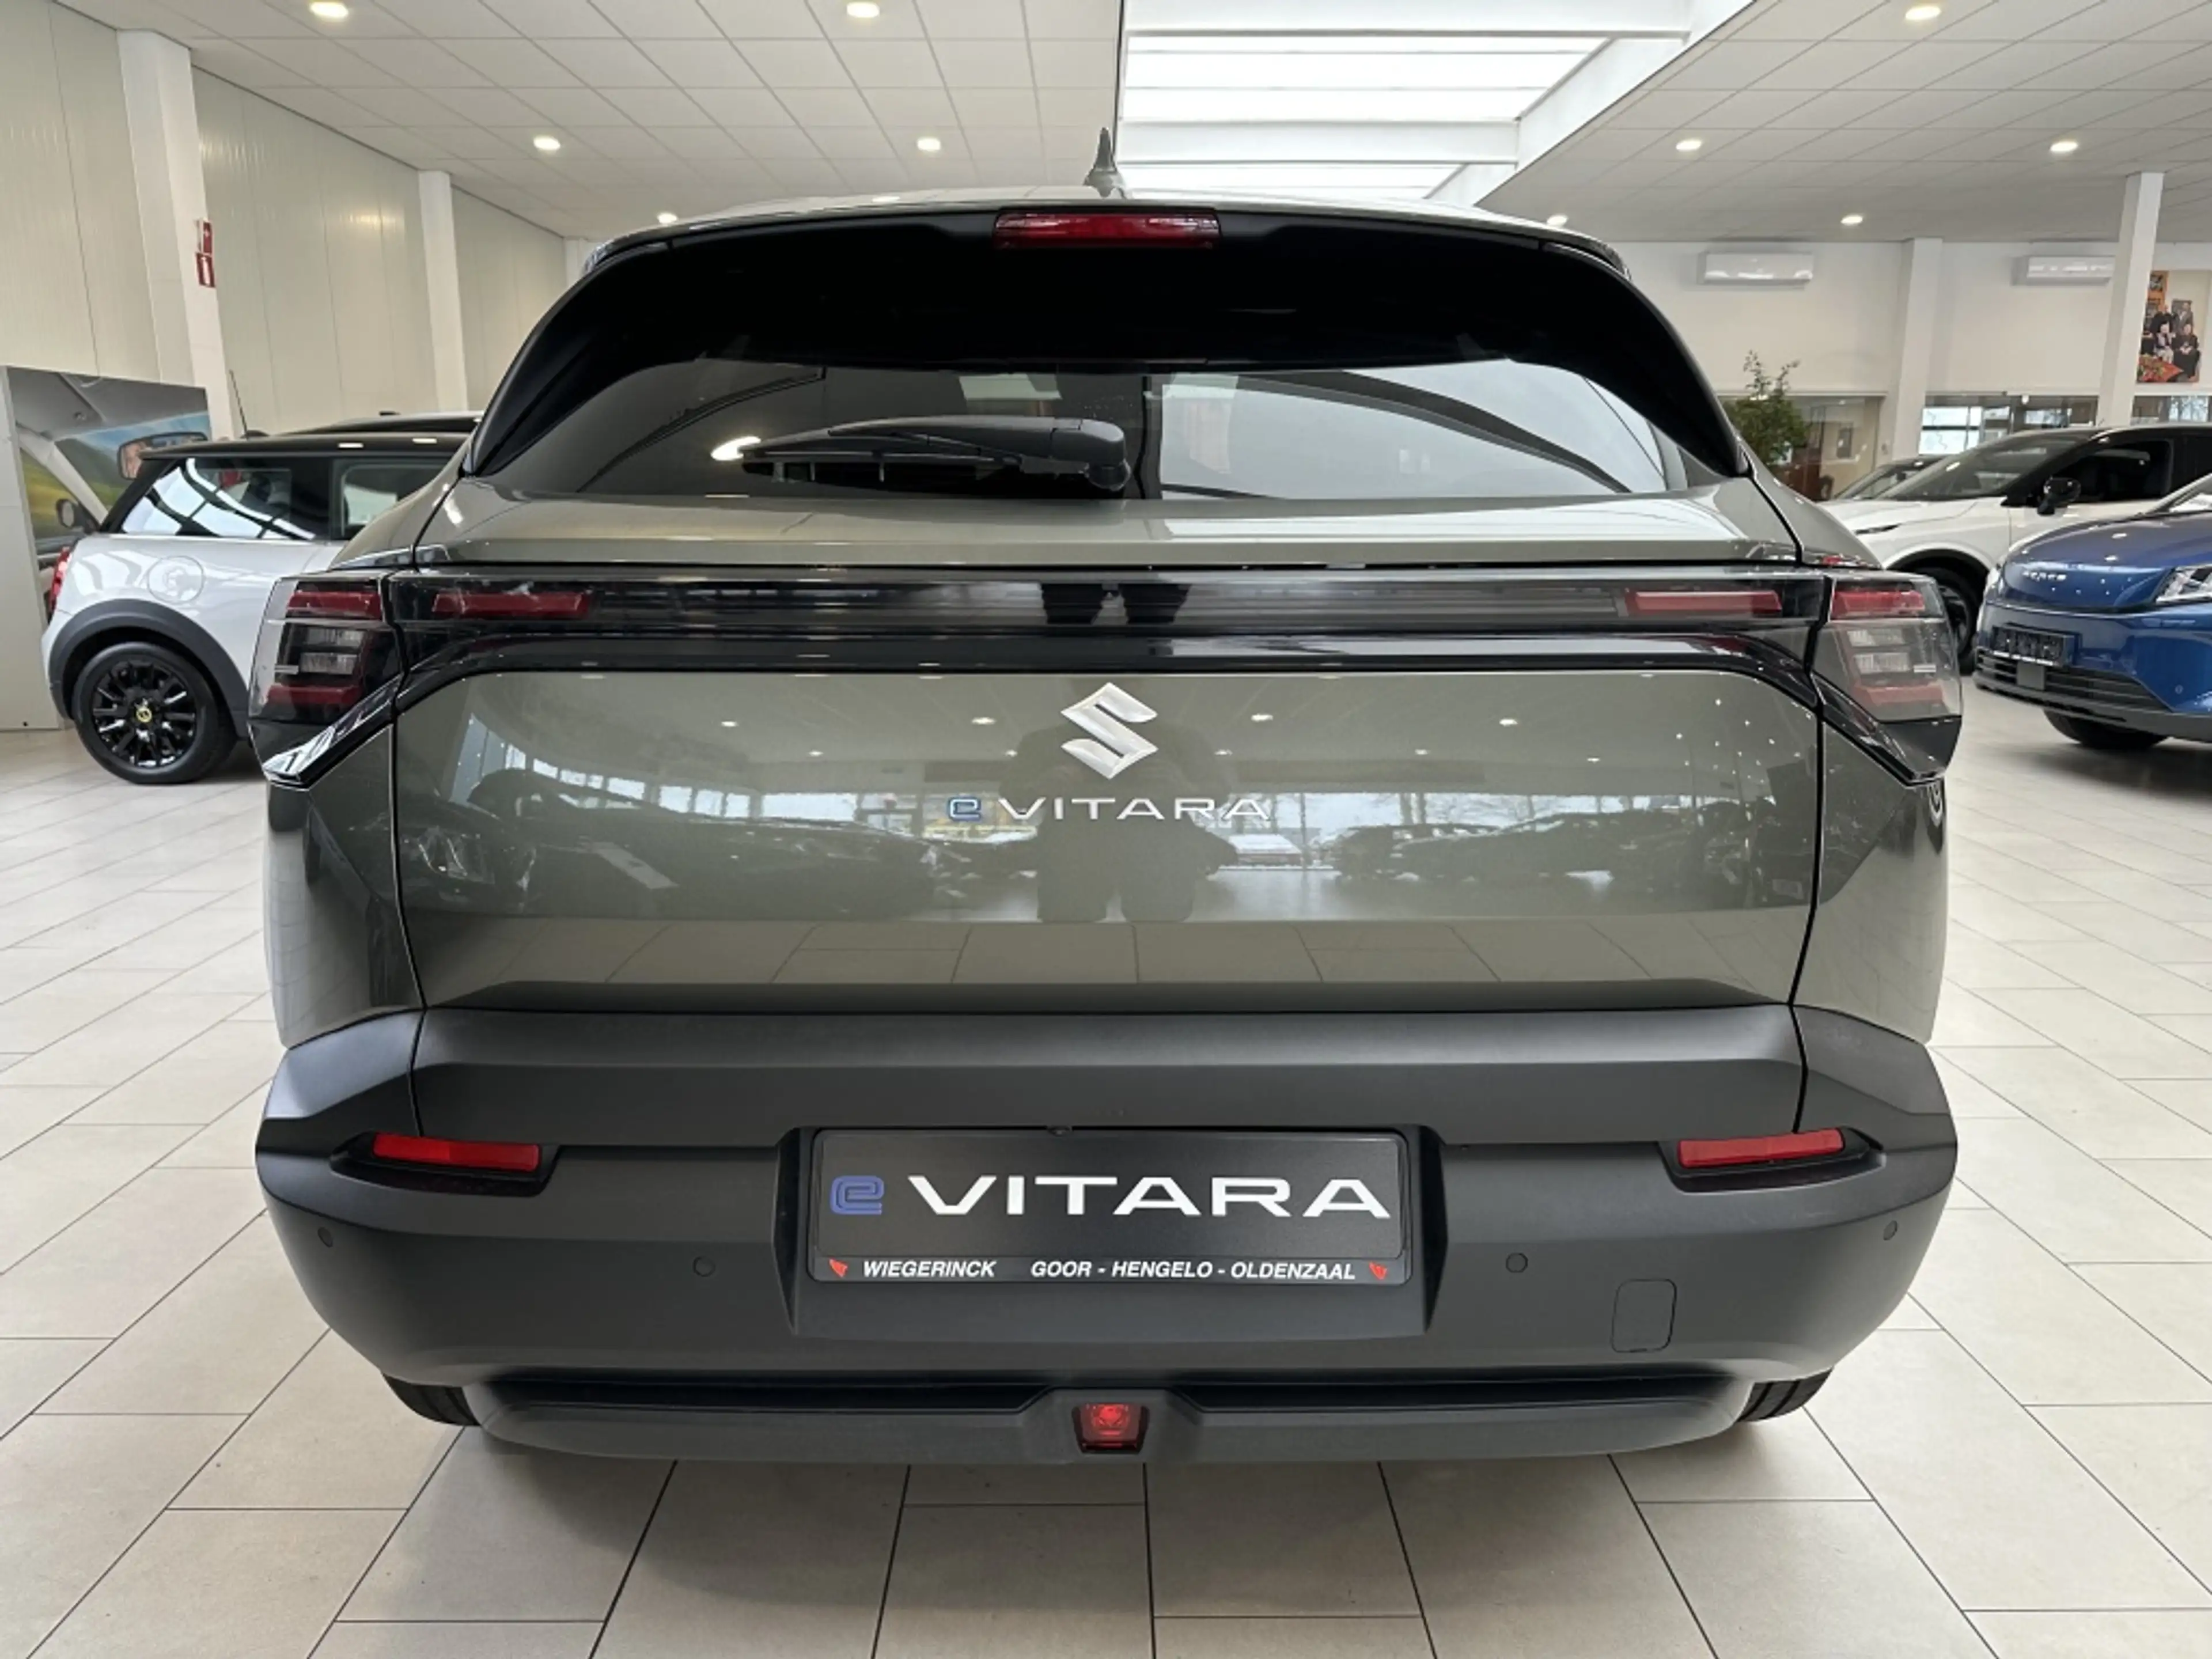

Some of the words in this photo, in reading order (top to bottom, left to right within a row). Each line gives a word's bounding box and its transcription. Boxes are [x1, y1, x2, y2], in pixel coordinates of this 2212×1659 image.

[997, 797, 1270, 820] VITARA
[908, 1175, 1391, 1219] VITARA
[863, 1260, 997, 1278] WIEGERINCK
[1031, 1260, 1092, 1278] GOOR
[1112, 1261, 1213, 1278] HENGELO
[1230, 1261, 1356, 1281] OLDENZAAL
